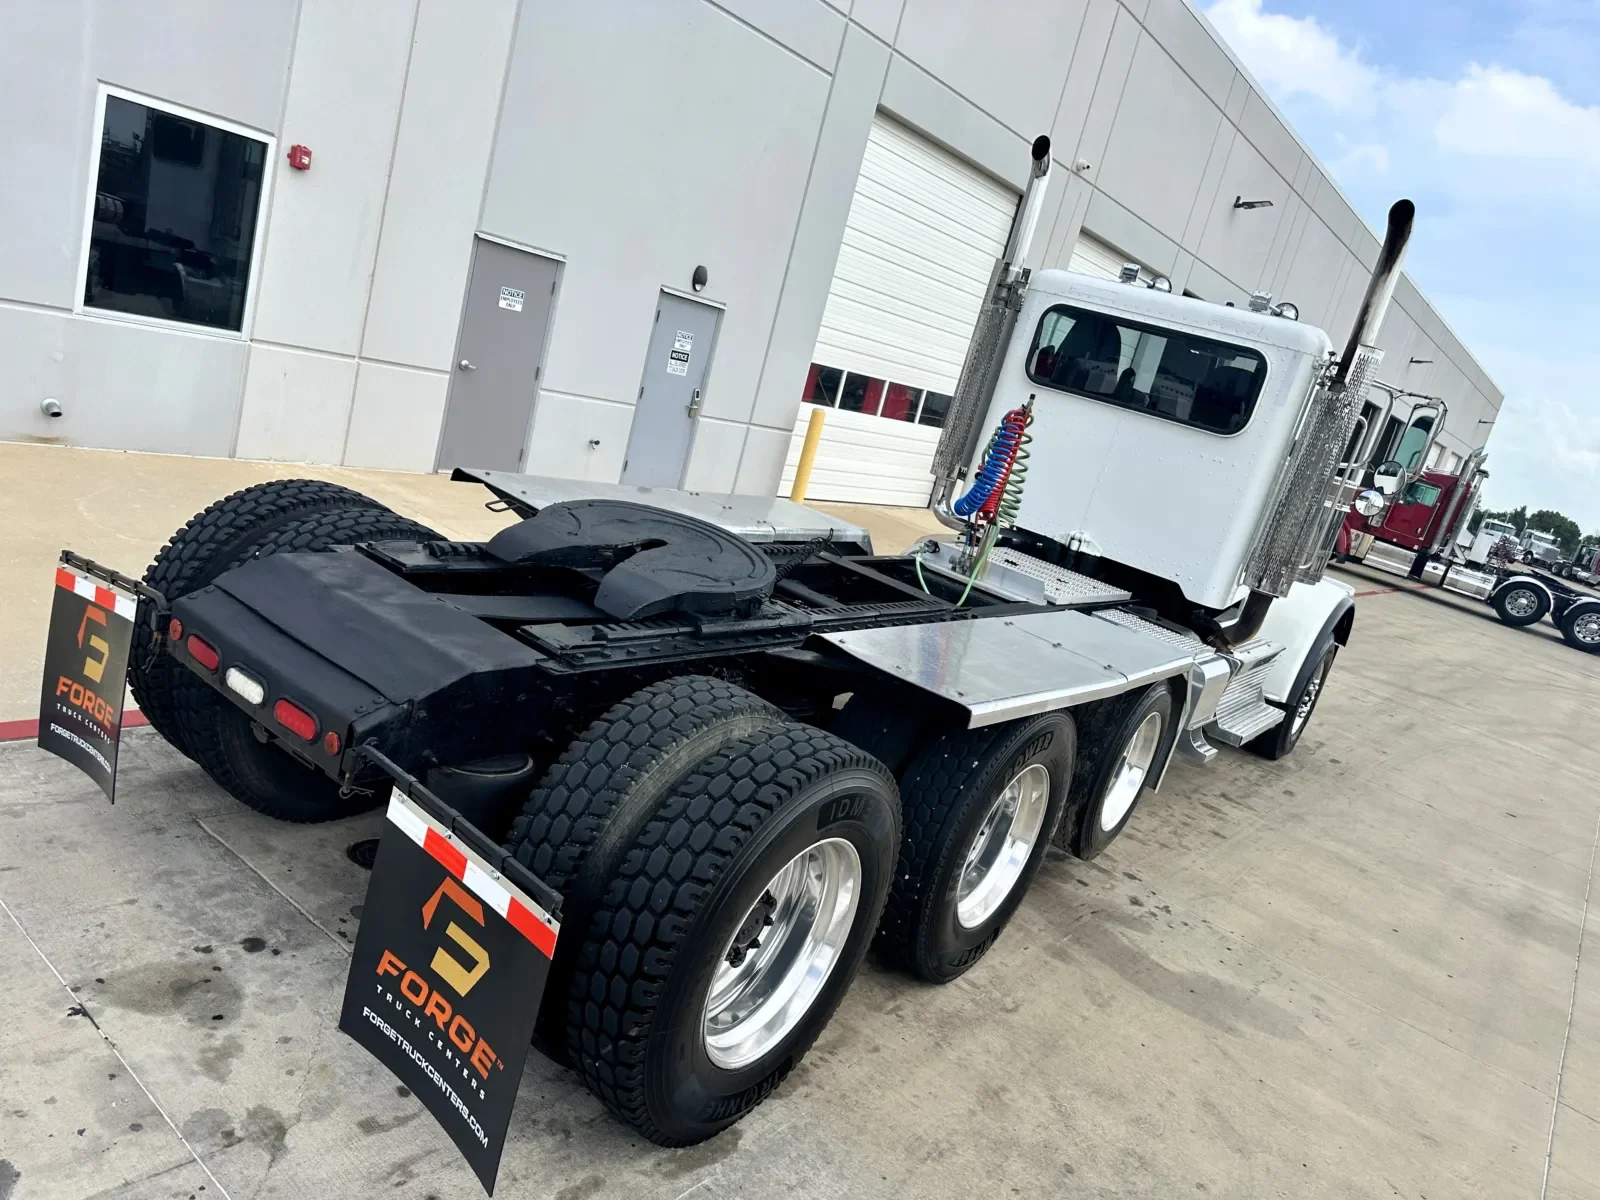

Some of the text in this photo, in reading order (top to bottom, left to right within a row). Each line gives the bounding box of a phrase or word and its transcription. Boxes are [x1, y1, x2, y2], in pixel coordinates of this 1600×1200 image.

[501, 287, 524, 299] NOTICE
[671, 351, 689, 361] NOTICE
[56, 676, 114, 729] FORGE
[56, 703, 111, 744] TRUCK CENTERS
[376, 949, 497, 1080] FORGE
[376, 984, 486, 1100] TRUCK CENTERS
[362, 1006, 489, 1149] FORGETRUCKCENTERS.COM
